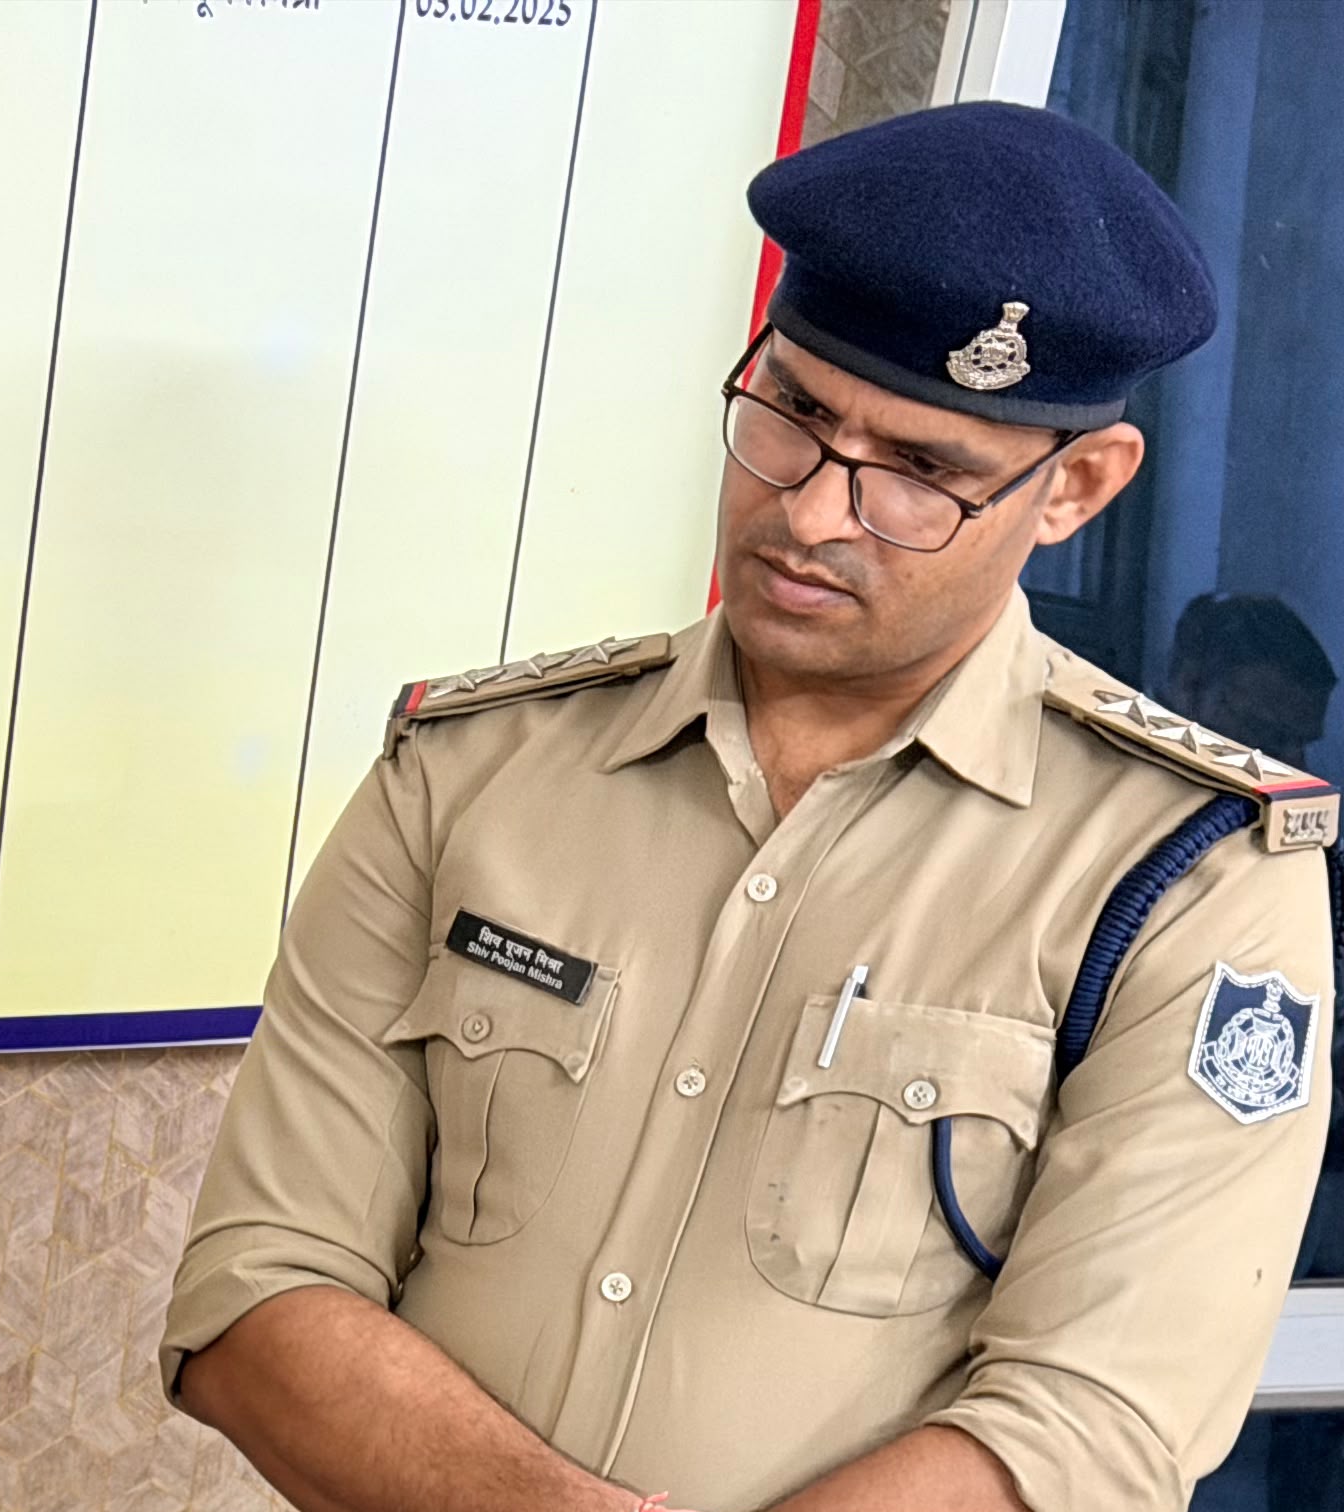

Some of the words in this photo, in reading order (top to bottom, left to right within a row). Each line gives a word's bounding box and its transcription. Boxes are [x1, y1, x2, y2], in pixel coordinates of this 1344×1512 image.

[467, 941, 491, 959] Shiv
[491, 951, 526, 974] Poojan
[527, 965, 563, 990] Mishra
[478, 926, 504, 949] शिव
[505, 940, 534, 963] पूजन
[534, 949, 564, 975] मिश्रा
